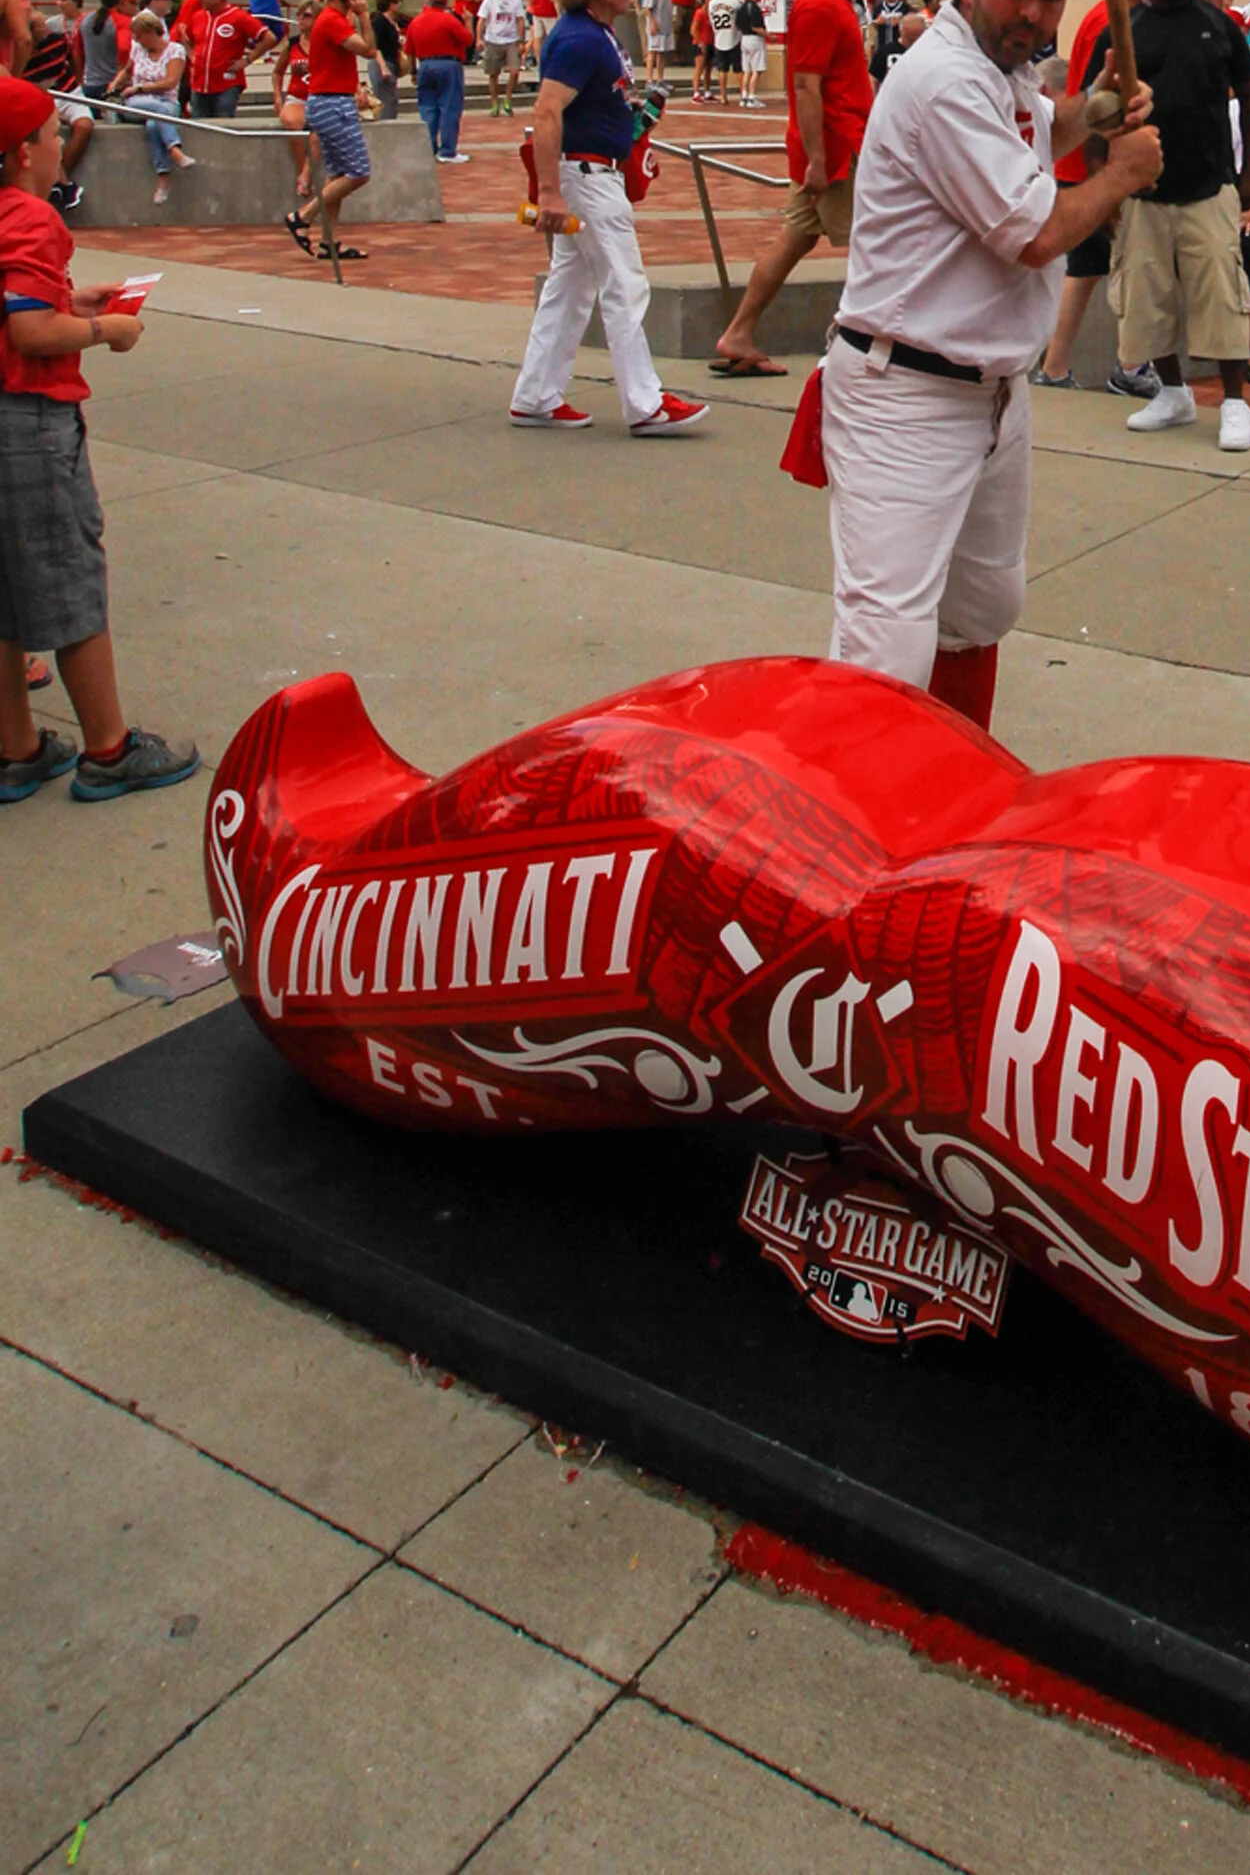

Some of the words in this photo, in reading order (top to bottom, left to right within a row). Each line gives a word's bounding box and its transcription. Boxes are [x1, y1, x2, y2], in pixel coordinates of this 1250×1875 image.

[712, 13, 731, 30] 22
[257, 847, 659, 1020] CINCINNATI
[981, 918, 1160, 1206] RED
[807, 1264, 831, 1285] 20
[888, 1298, 908, 1318] 15
[903, 1220, 999, 1306] GAME
